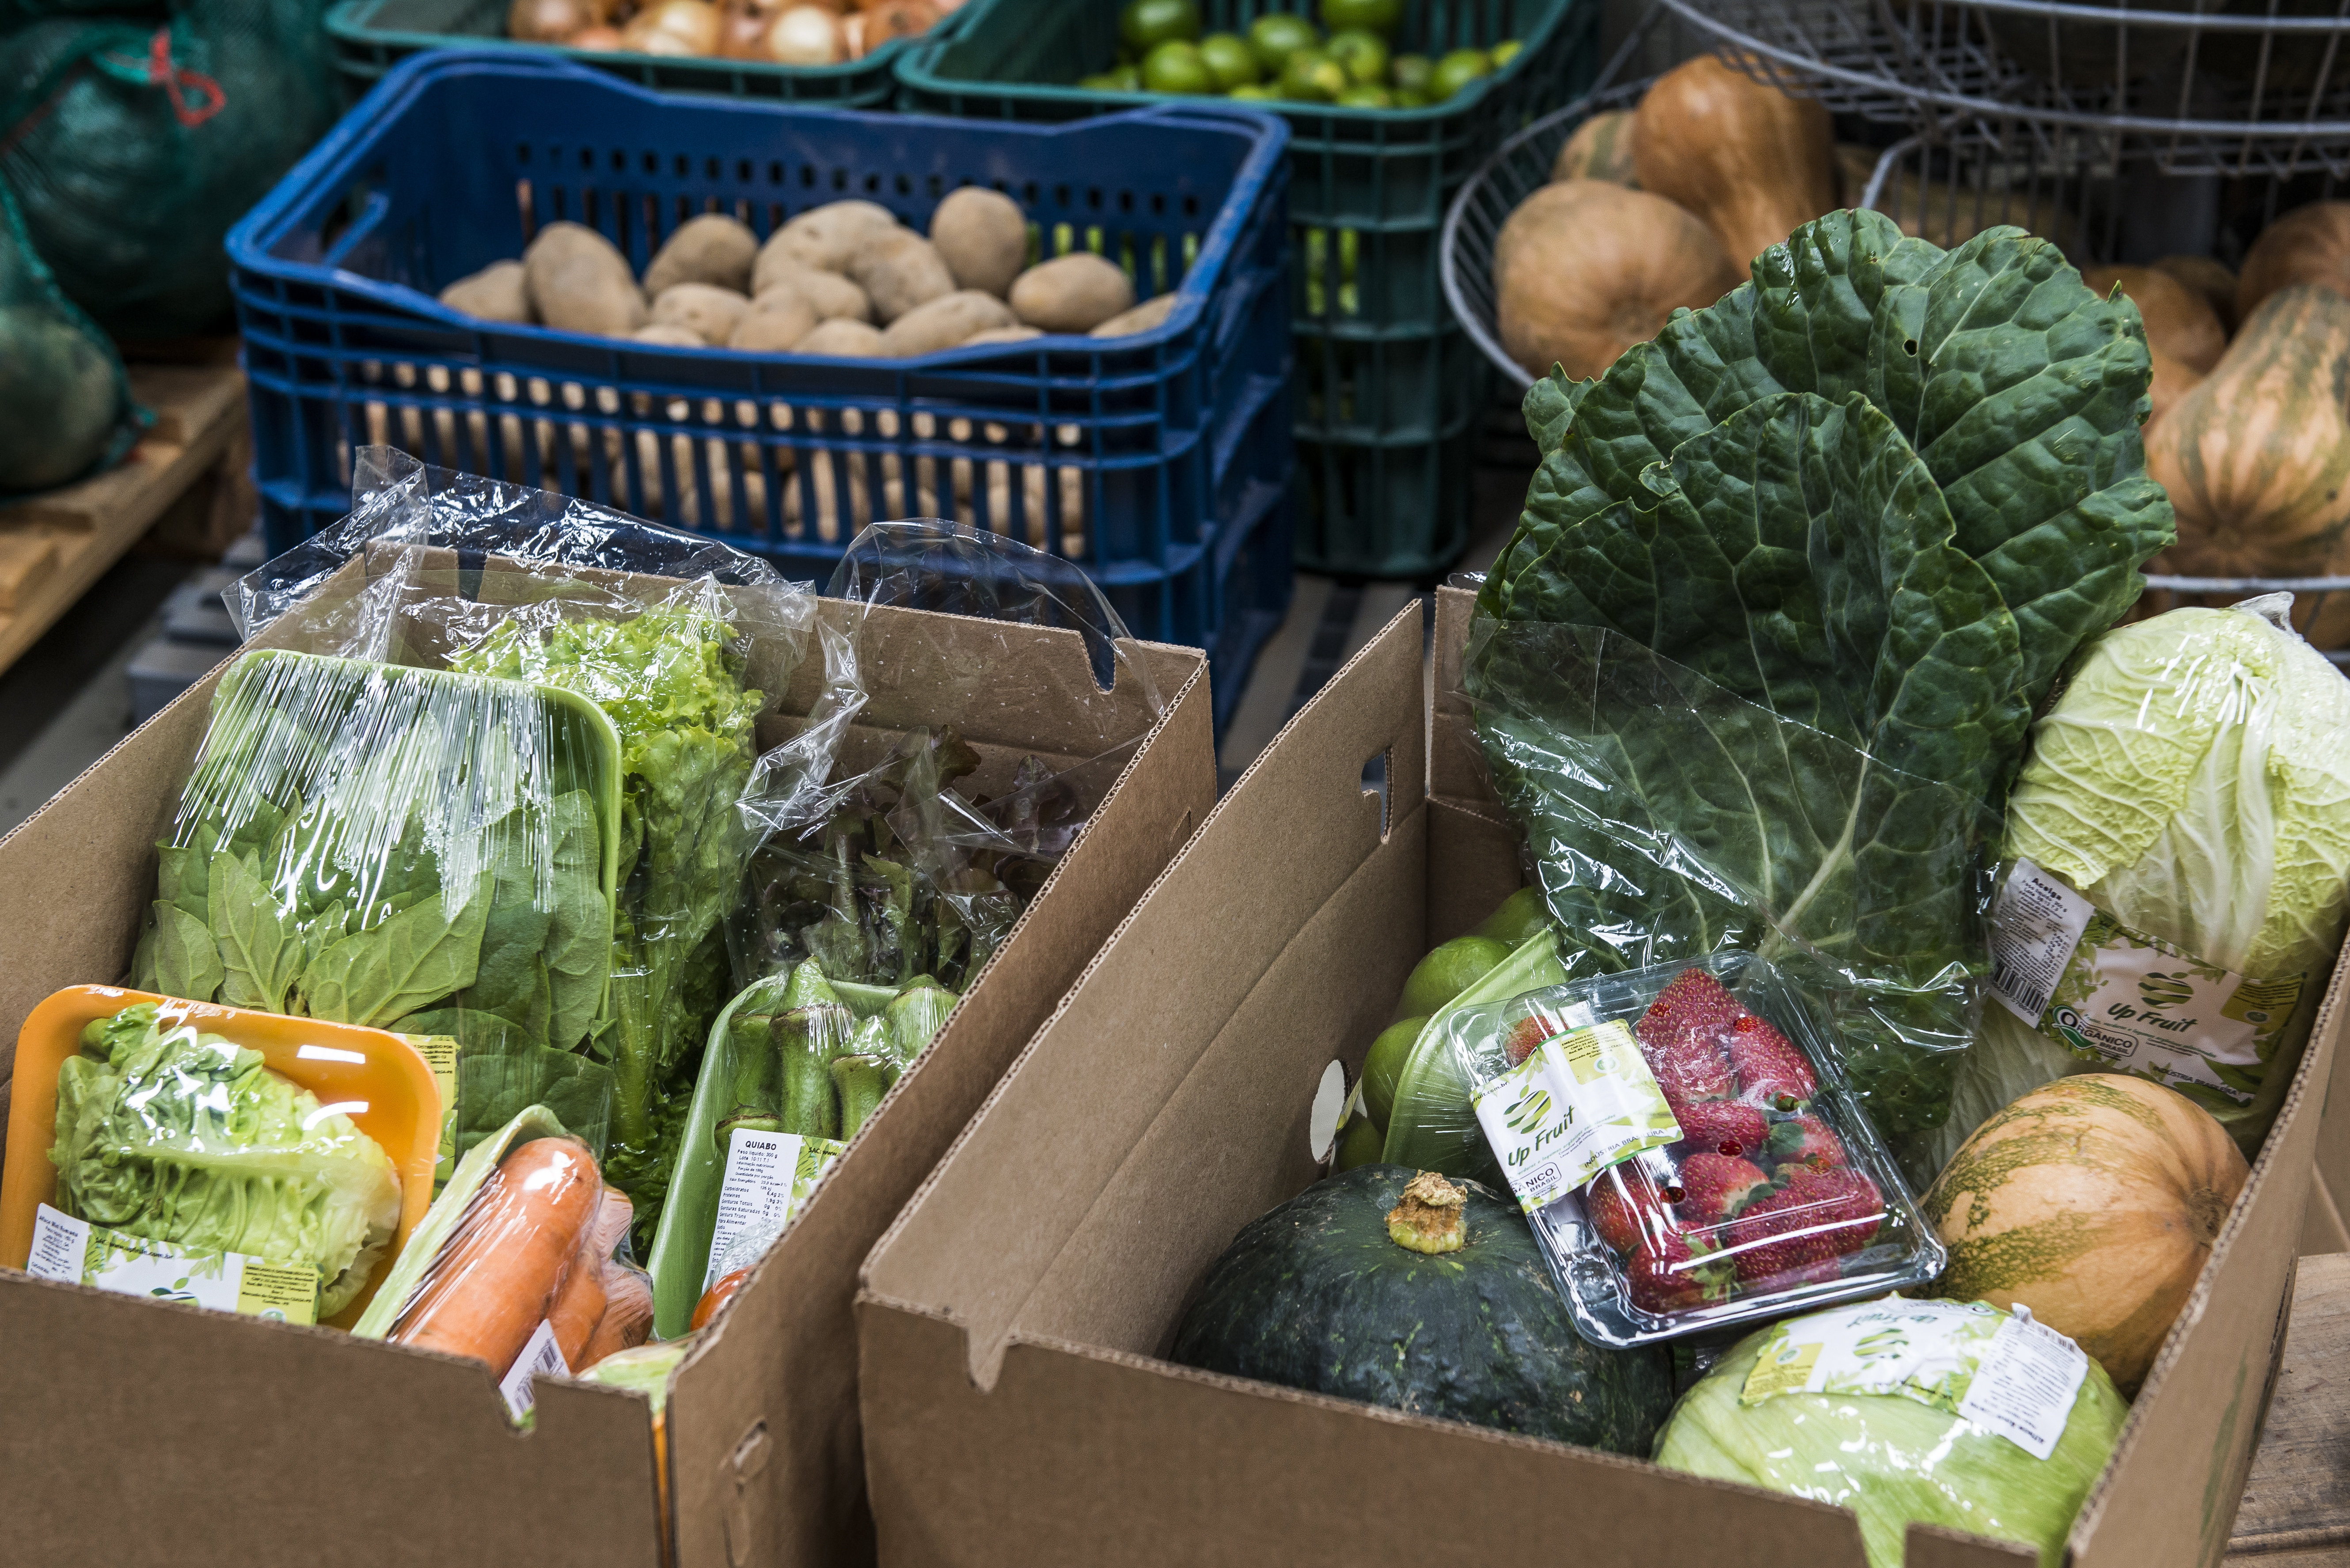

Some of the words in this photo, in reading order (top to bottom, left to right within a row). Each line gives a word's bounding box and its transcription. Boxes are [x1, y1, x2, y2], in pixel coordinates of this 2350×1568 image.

[2107, 1003, 2136, 1020] Up
[2137, 1011, 2198, 1033] Fruit
[1562, 1036, 1583, 1046] EMBALADO
[2099, 1042, 2129, 1054] BRASIL
[1508, 1147, 1530, 1167] Up
[1535, 1105, 1575, 1151] Fruit
[745, 1141, 777, 1151] QUIABO
[1584, 1143, 1621, 1168] INDÚSTRIA
[1530, 1176, 1558, 1192] BRASIL
